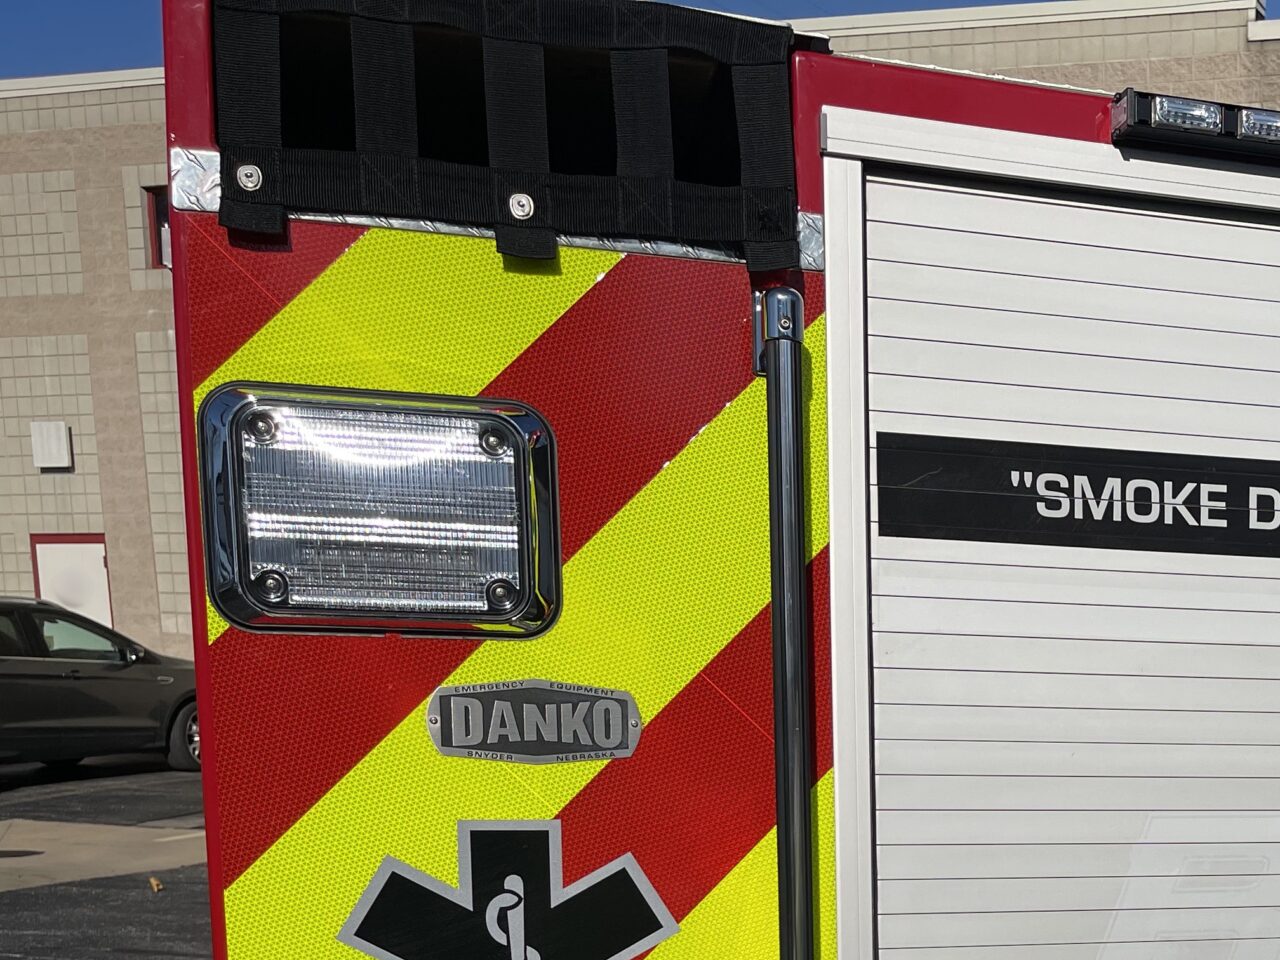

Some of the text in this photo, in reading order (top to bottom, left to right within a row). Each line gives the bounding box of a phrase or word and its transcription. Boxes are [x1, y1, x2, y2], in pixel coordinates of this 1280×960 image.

[1011, 470, 1228, 528] "SMOKE
[454, 680, 615, 697] EMERGENCY EQUIPMENT
[450, 696, 623, 748] DANKO
[466, 750, 617, 762] SNYDER NEBRASKA
